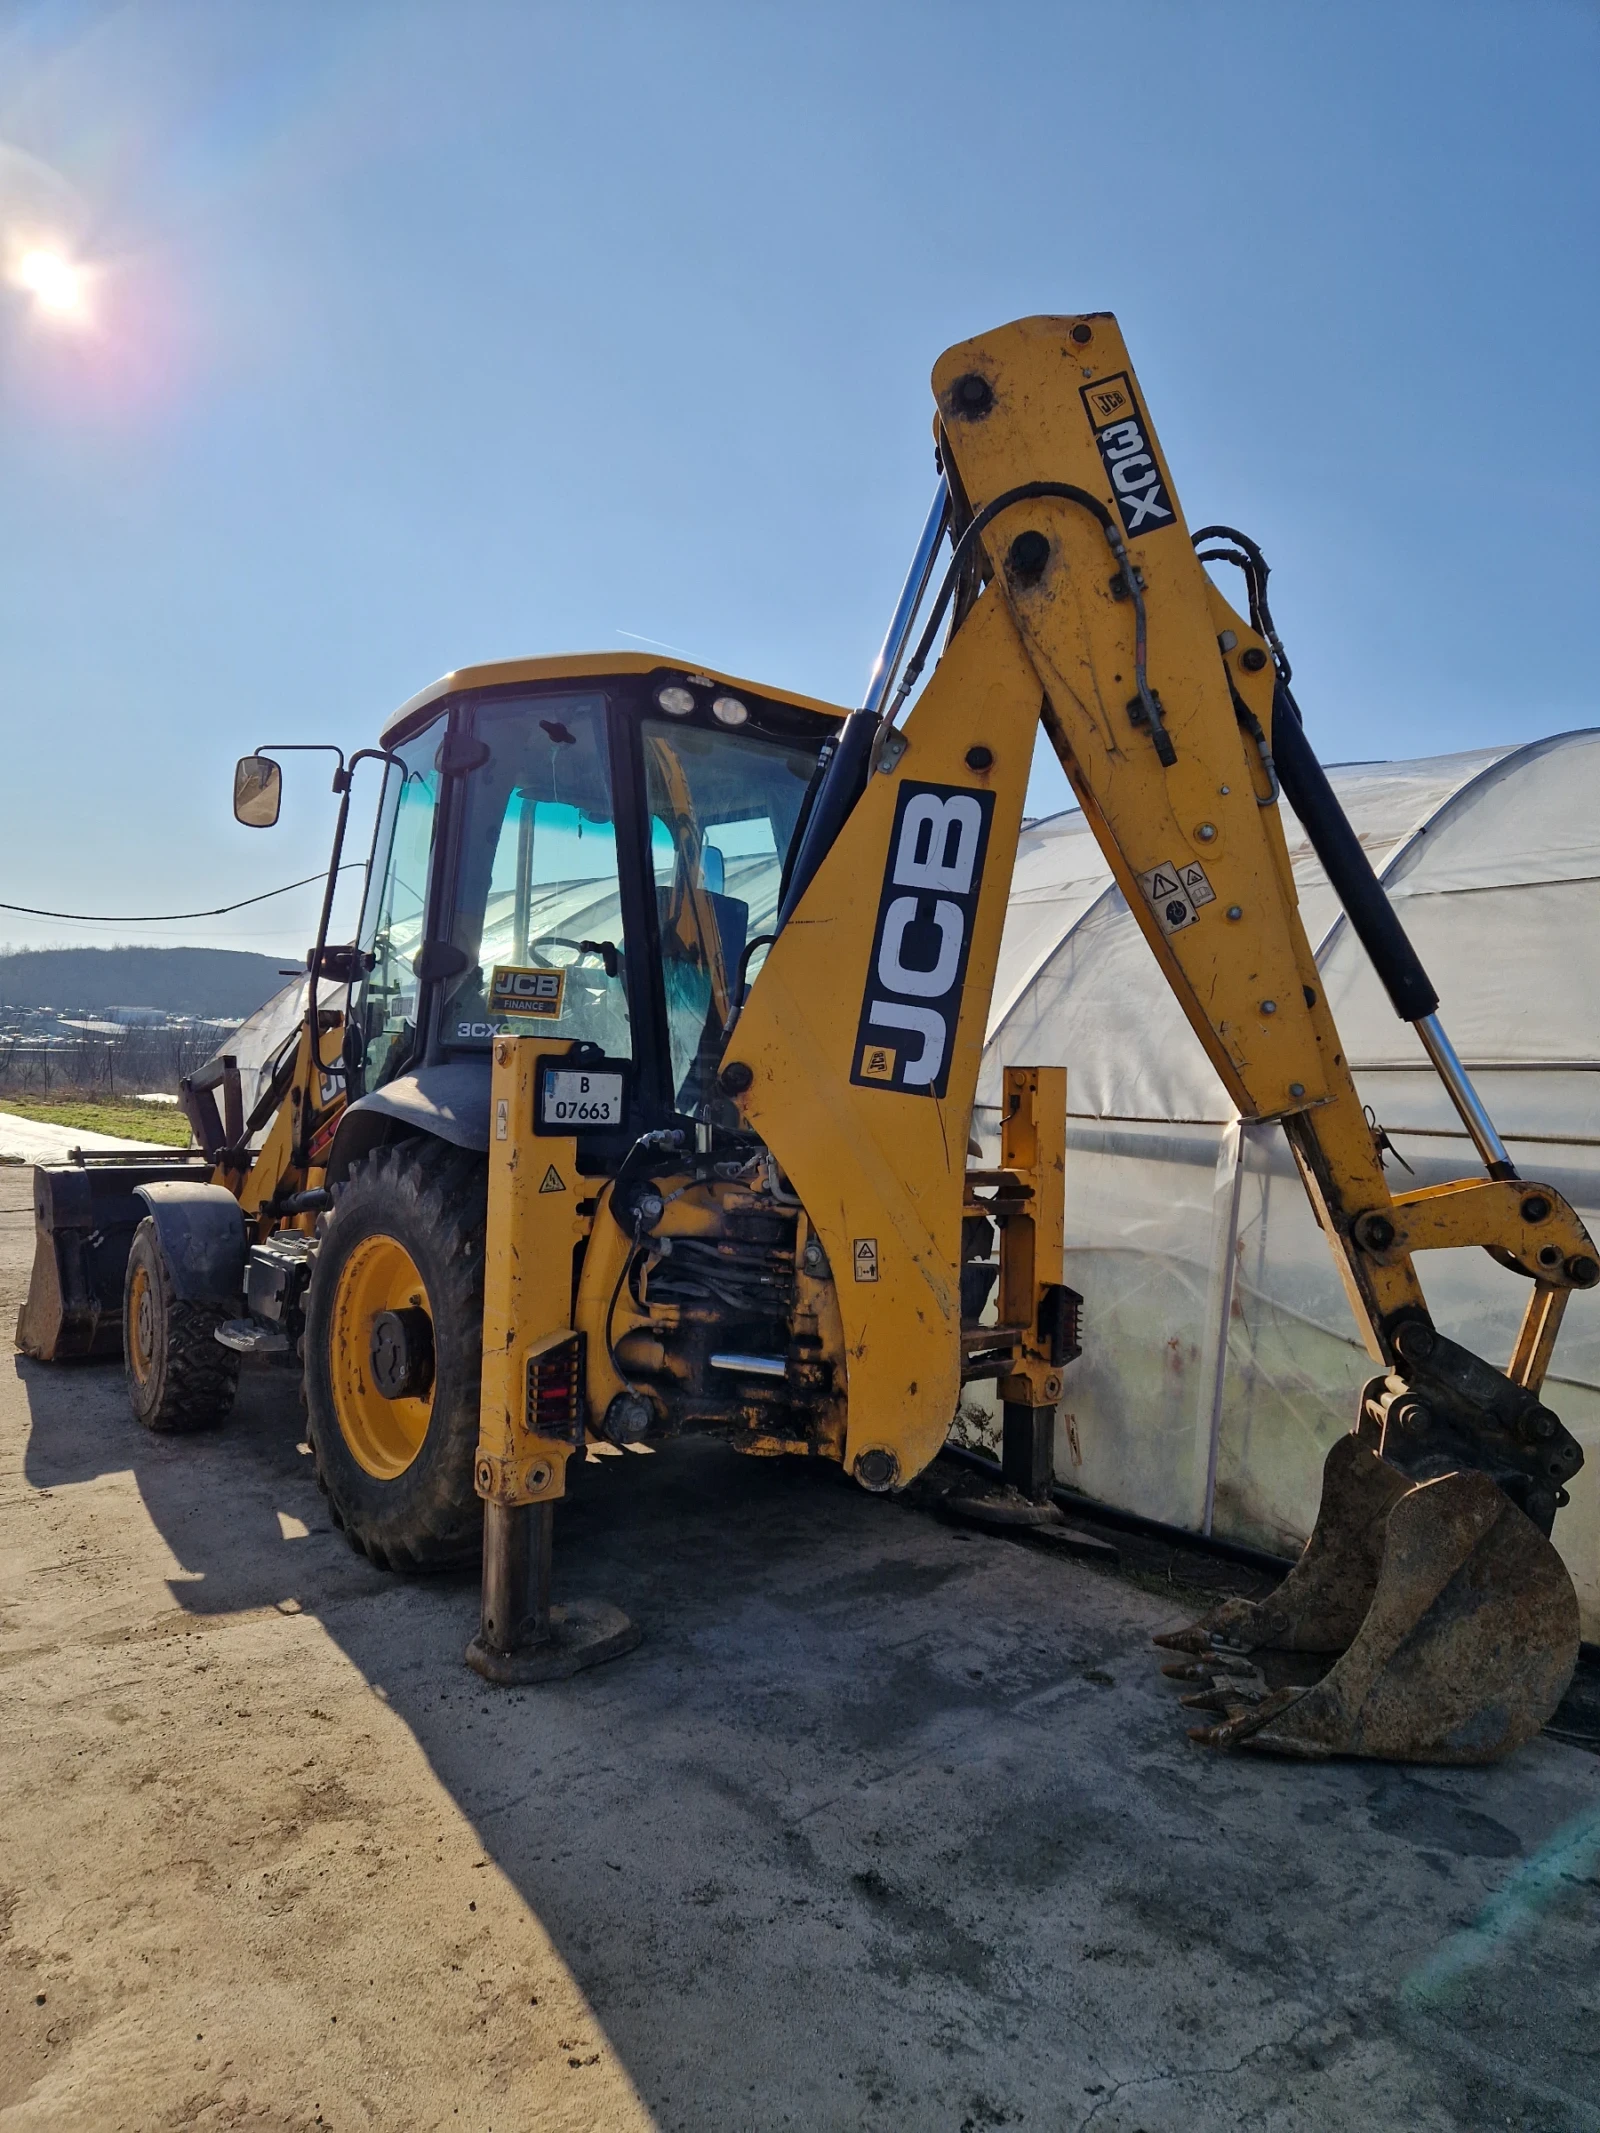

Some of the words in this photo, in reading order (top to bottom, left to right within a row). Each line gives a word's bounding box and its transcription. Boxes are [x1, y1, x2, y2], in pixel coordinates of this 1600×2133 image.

[1097, 391, 1124, 415] JCB
[1101, 420, 1172, 529] 3CX
[868, 793, 982, 1085] JCB
[495, 973, 559, 997] JCB
[503, 999, 545, 1011] FINANCE
[869, 1052, 886, 1071] JCB
[580, 1076, 590, 1093] B
[555, 1101, 610, 1120] 07663
